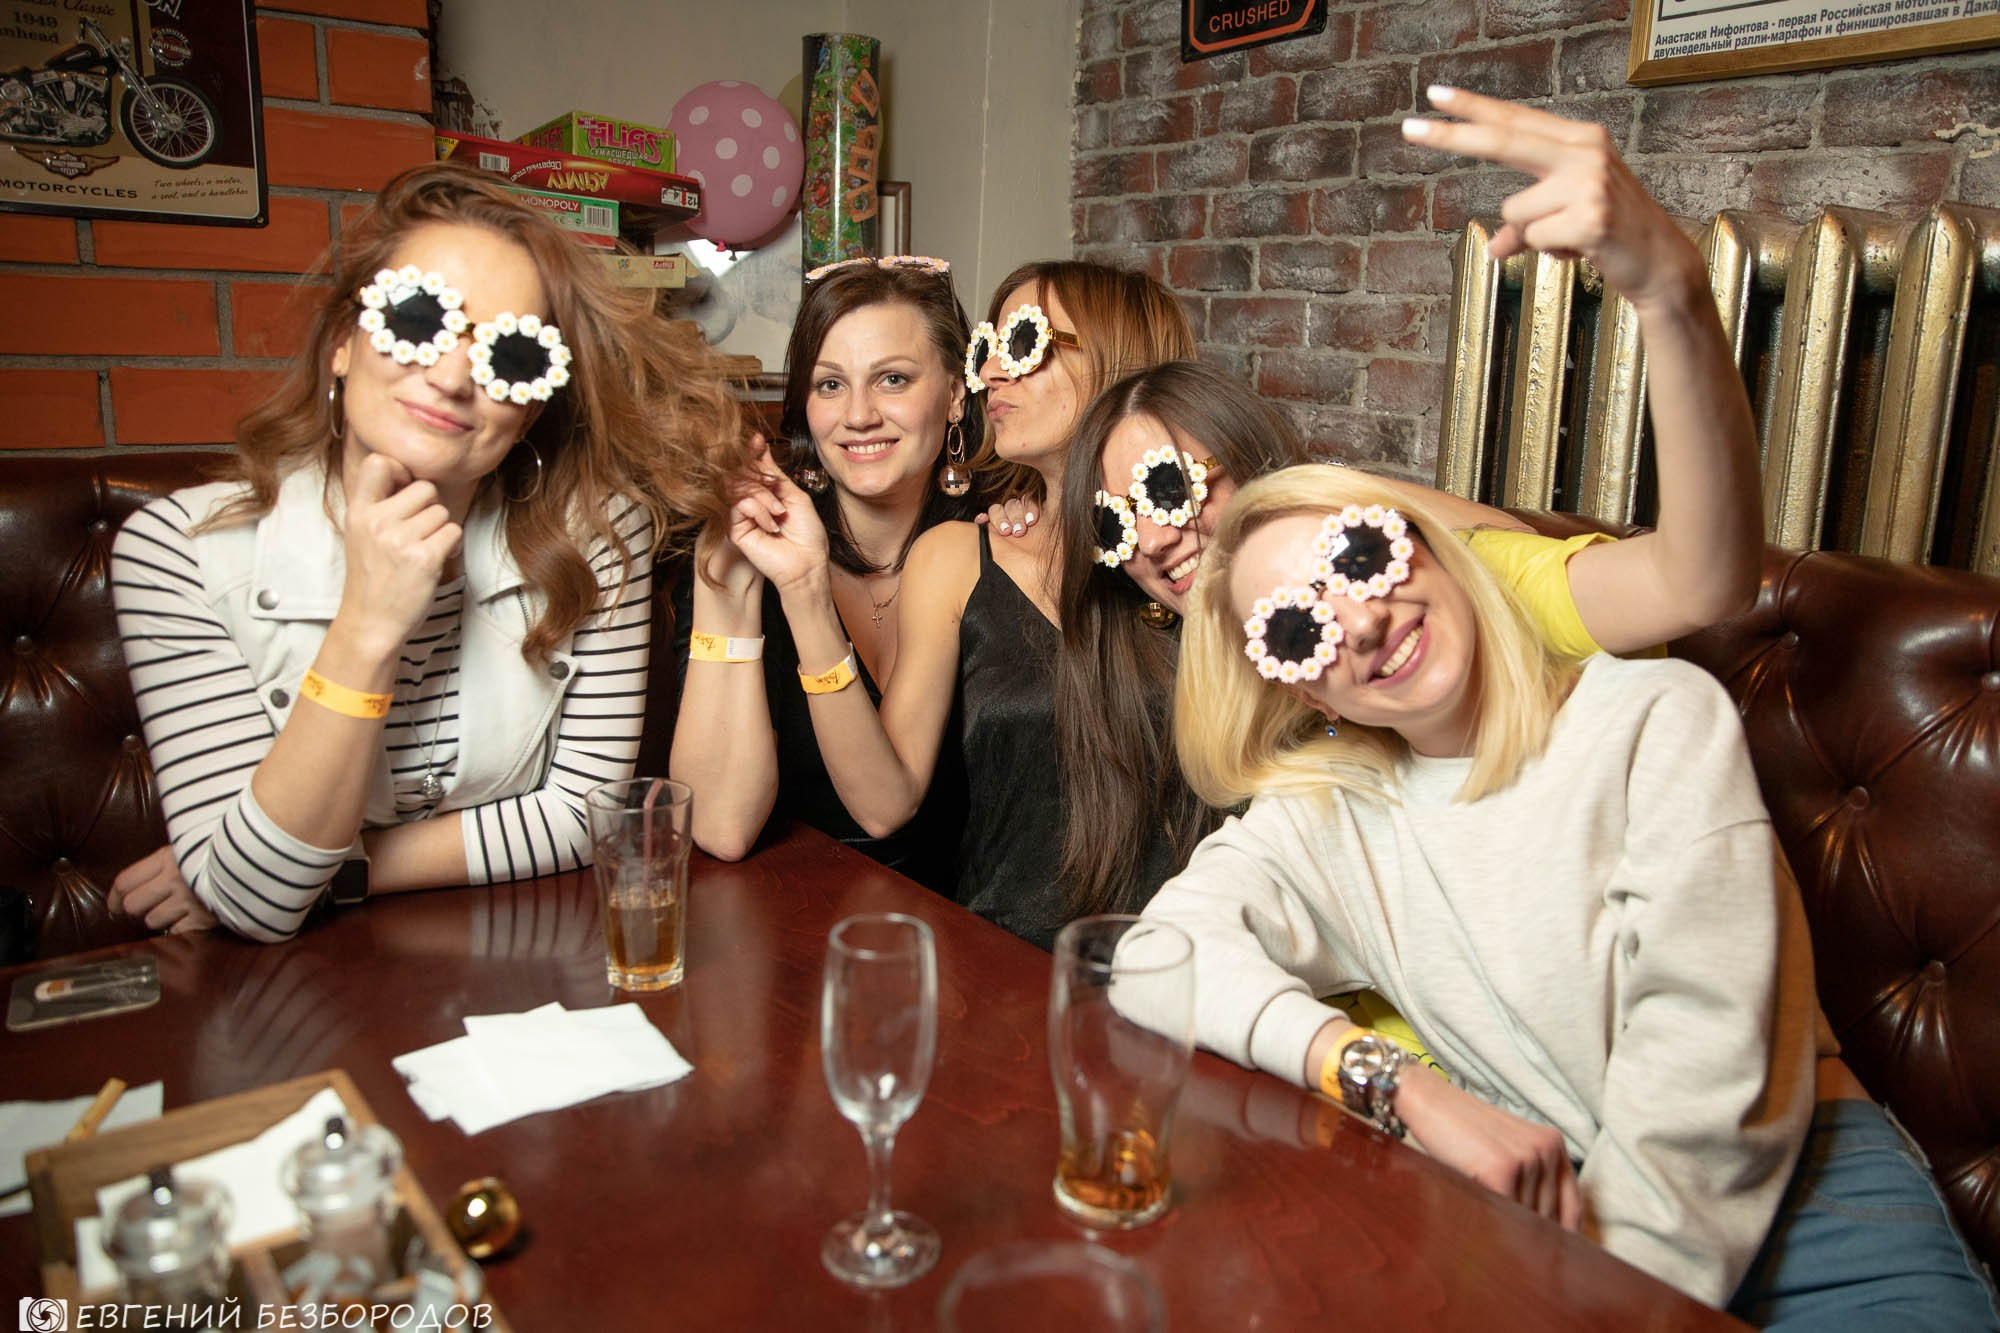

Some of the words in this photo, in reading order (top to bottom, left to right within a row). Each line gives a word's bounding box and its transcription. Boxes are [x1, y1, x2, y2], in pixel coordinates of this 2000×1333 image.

[1208, 0, 1291, 33] CRUSHED
[1653, 37, 1732, 60] двухнедельный
[1734, 25, 1822, 50] ралли-марафон
[1825, 24, 1833, 34] и
[1836, 11, 1949, 35] финишировавшая
[1952, 5, 1960, 17] в
[1962, 0, 2000, 17] Дака
[1655, 30, 1707, 47] Анастасия
[1710, 20, 1769, 40] Нифонтова
[1778, 13, 1817, 31] первая
[1820, 1, 1891, 23] Российская
[0, 179, 138, 199] MOTORCYCLES
[546, 171, 609, 192] ACTIVITY
[520, 194, 579, 211] MONOPOLY
